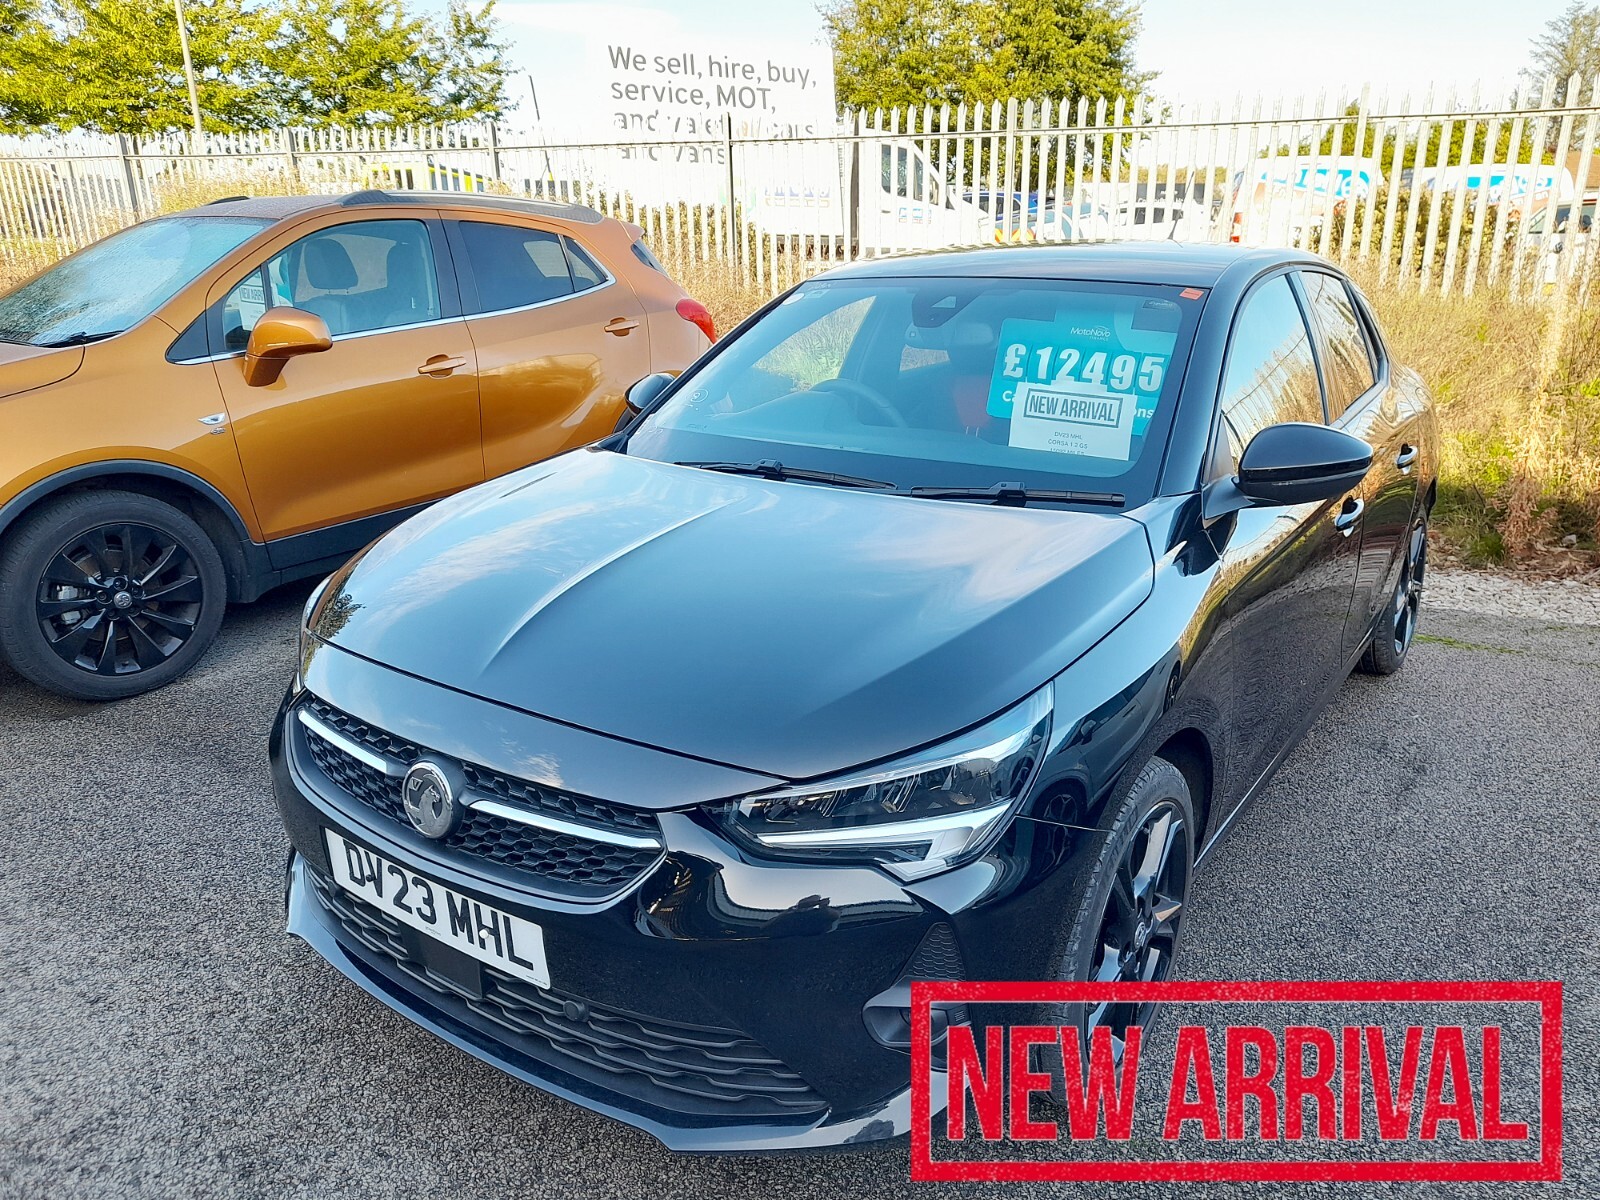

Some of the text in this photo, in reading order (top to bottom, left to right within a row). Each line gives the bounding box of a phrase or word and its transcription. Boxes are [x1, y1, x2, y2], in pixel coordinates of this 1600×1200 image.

[608, 44, 817, 90] We sell, hire, buy,
[611, 80, 776, 114] service, MOT,
[1070, 326, 1111, 337] MotoNovo
[1002, 343, 1165, 392] £12495
[1029, 394, 1116, 422] NEW ARRIVAL
[1047, 439, 1069, 447] CORSA
[342, 838, 534, 971] DV23 MHL
